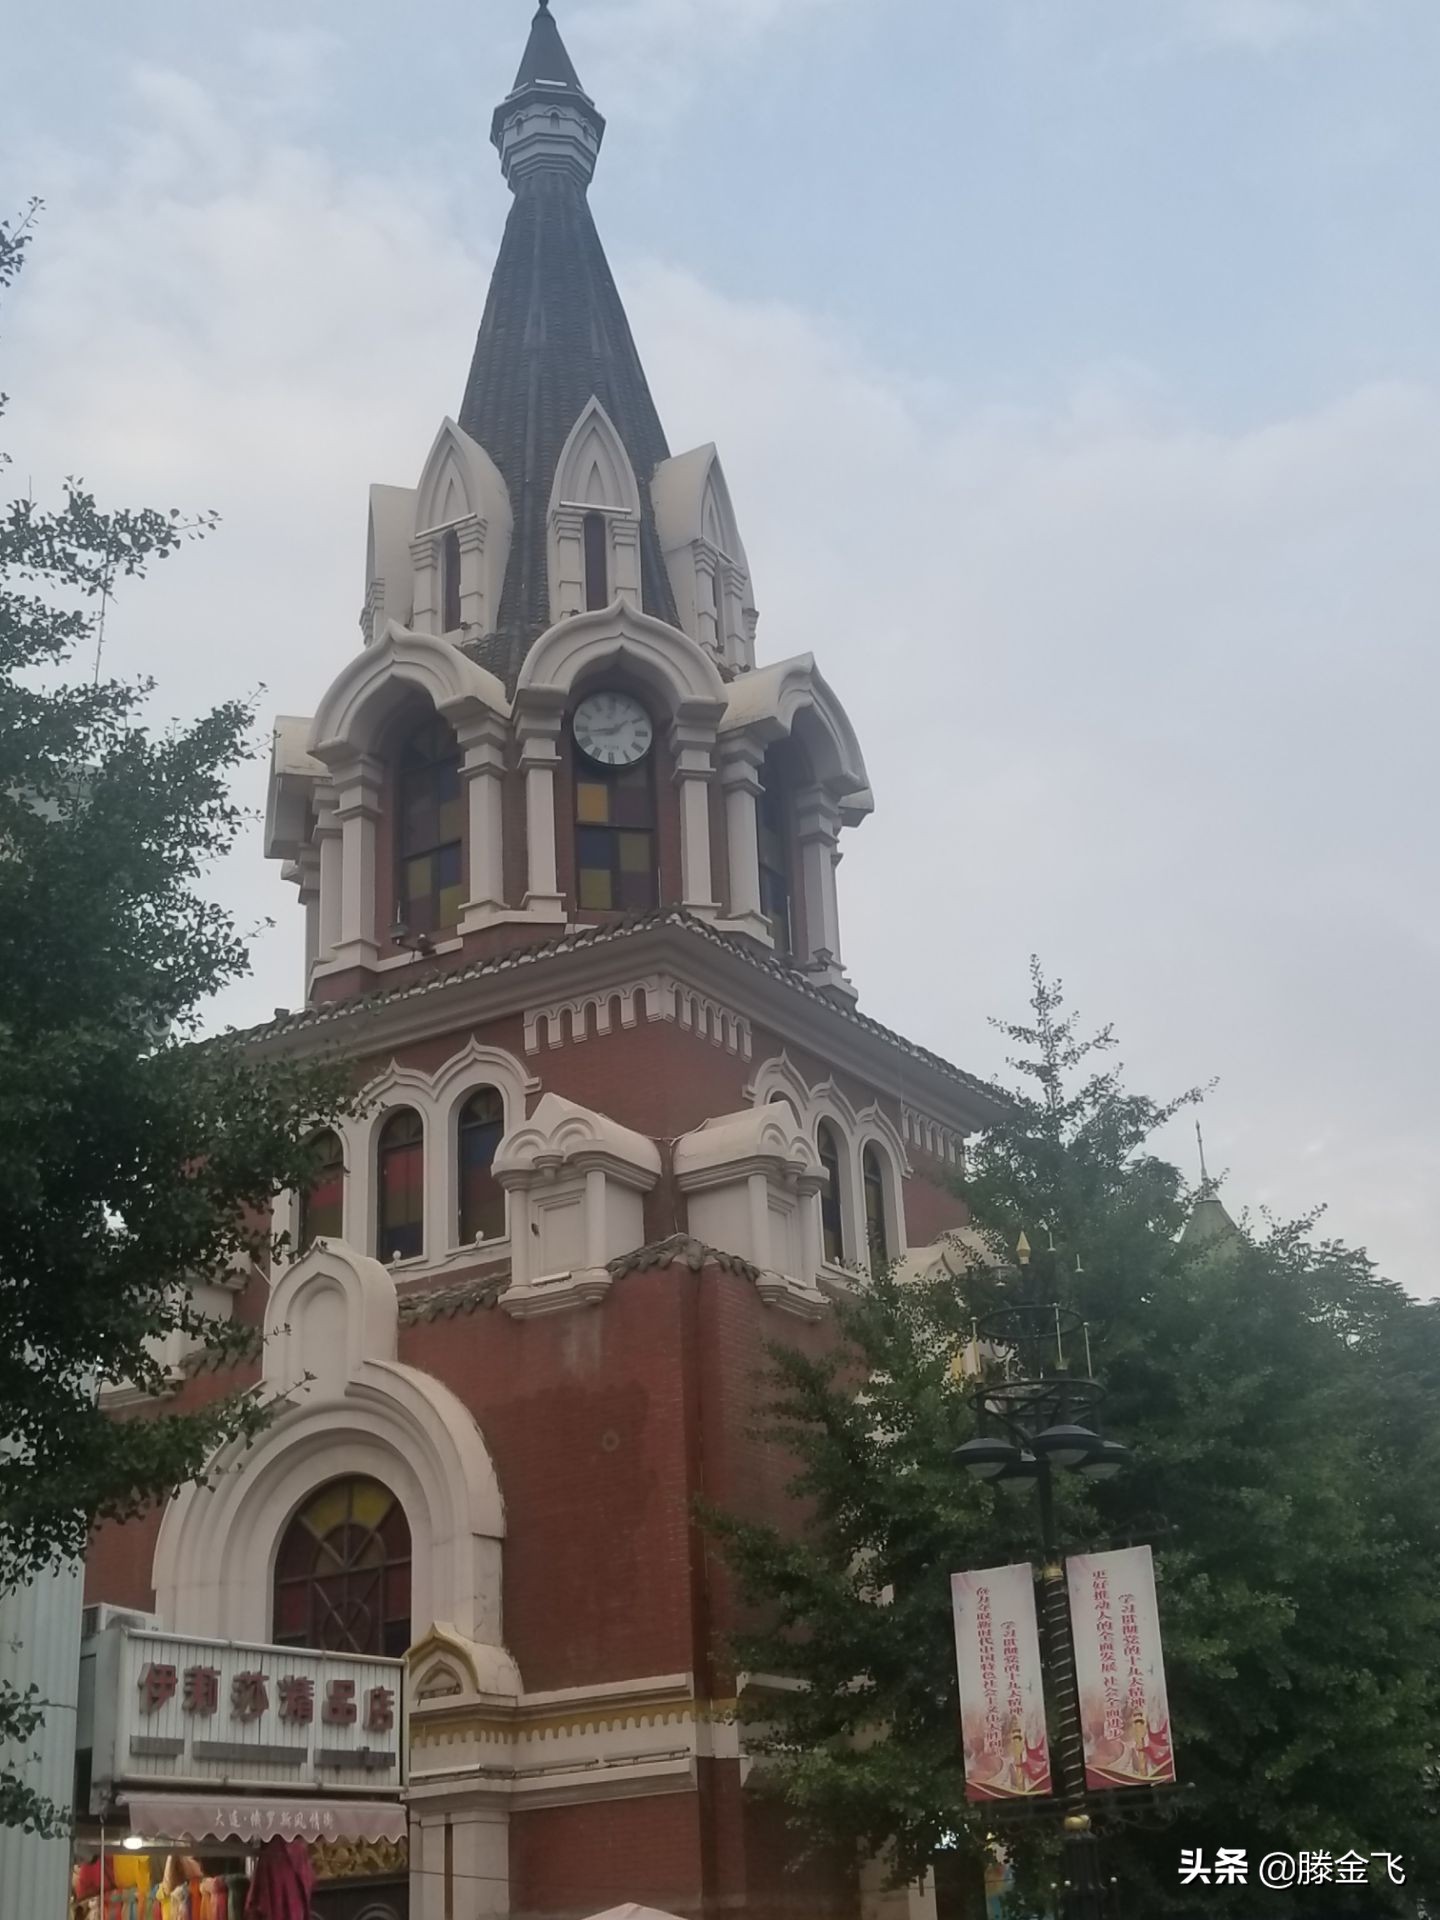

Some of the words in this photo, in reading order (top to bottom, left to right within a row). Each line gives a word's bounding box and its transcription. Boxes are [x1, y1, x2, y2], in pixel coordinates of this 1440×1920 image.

[137, 1661, 396, 1733] 伊莉莎精品店
